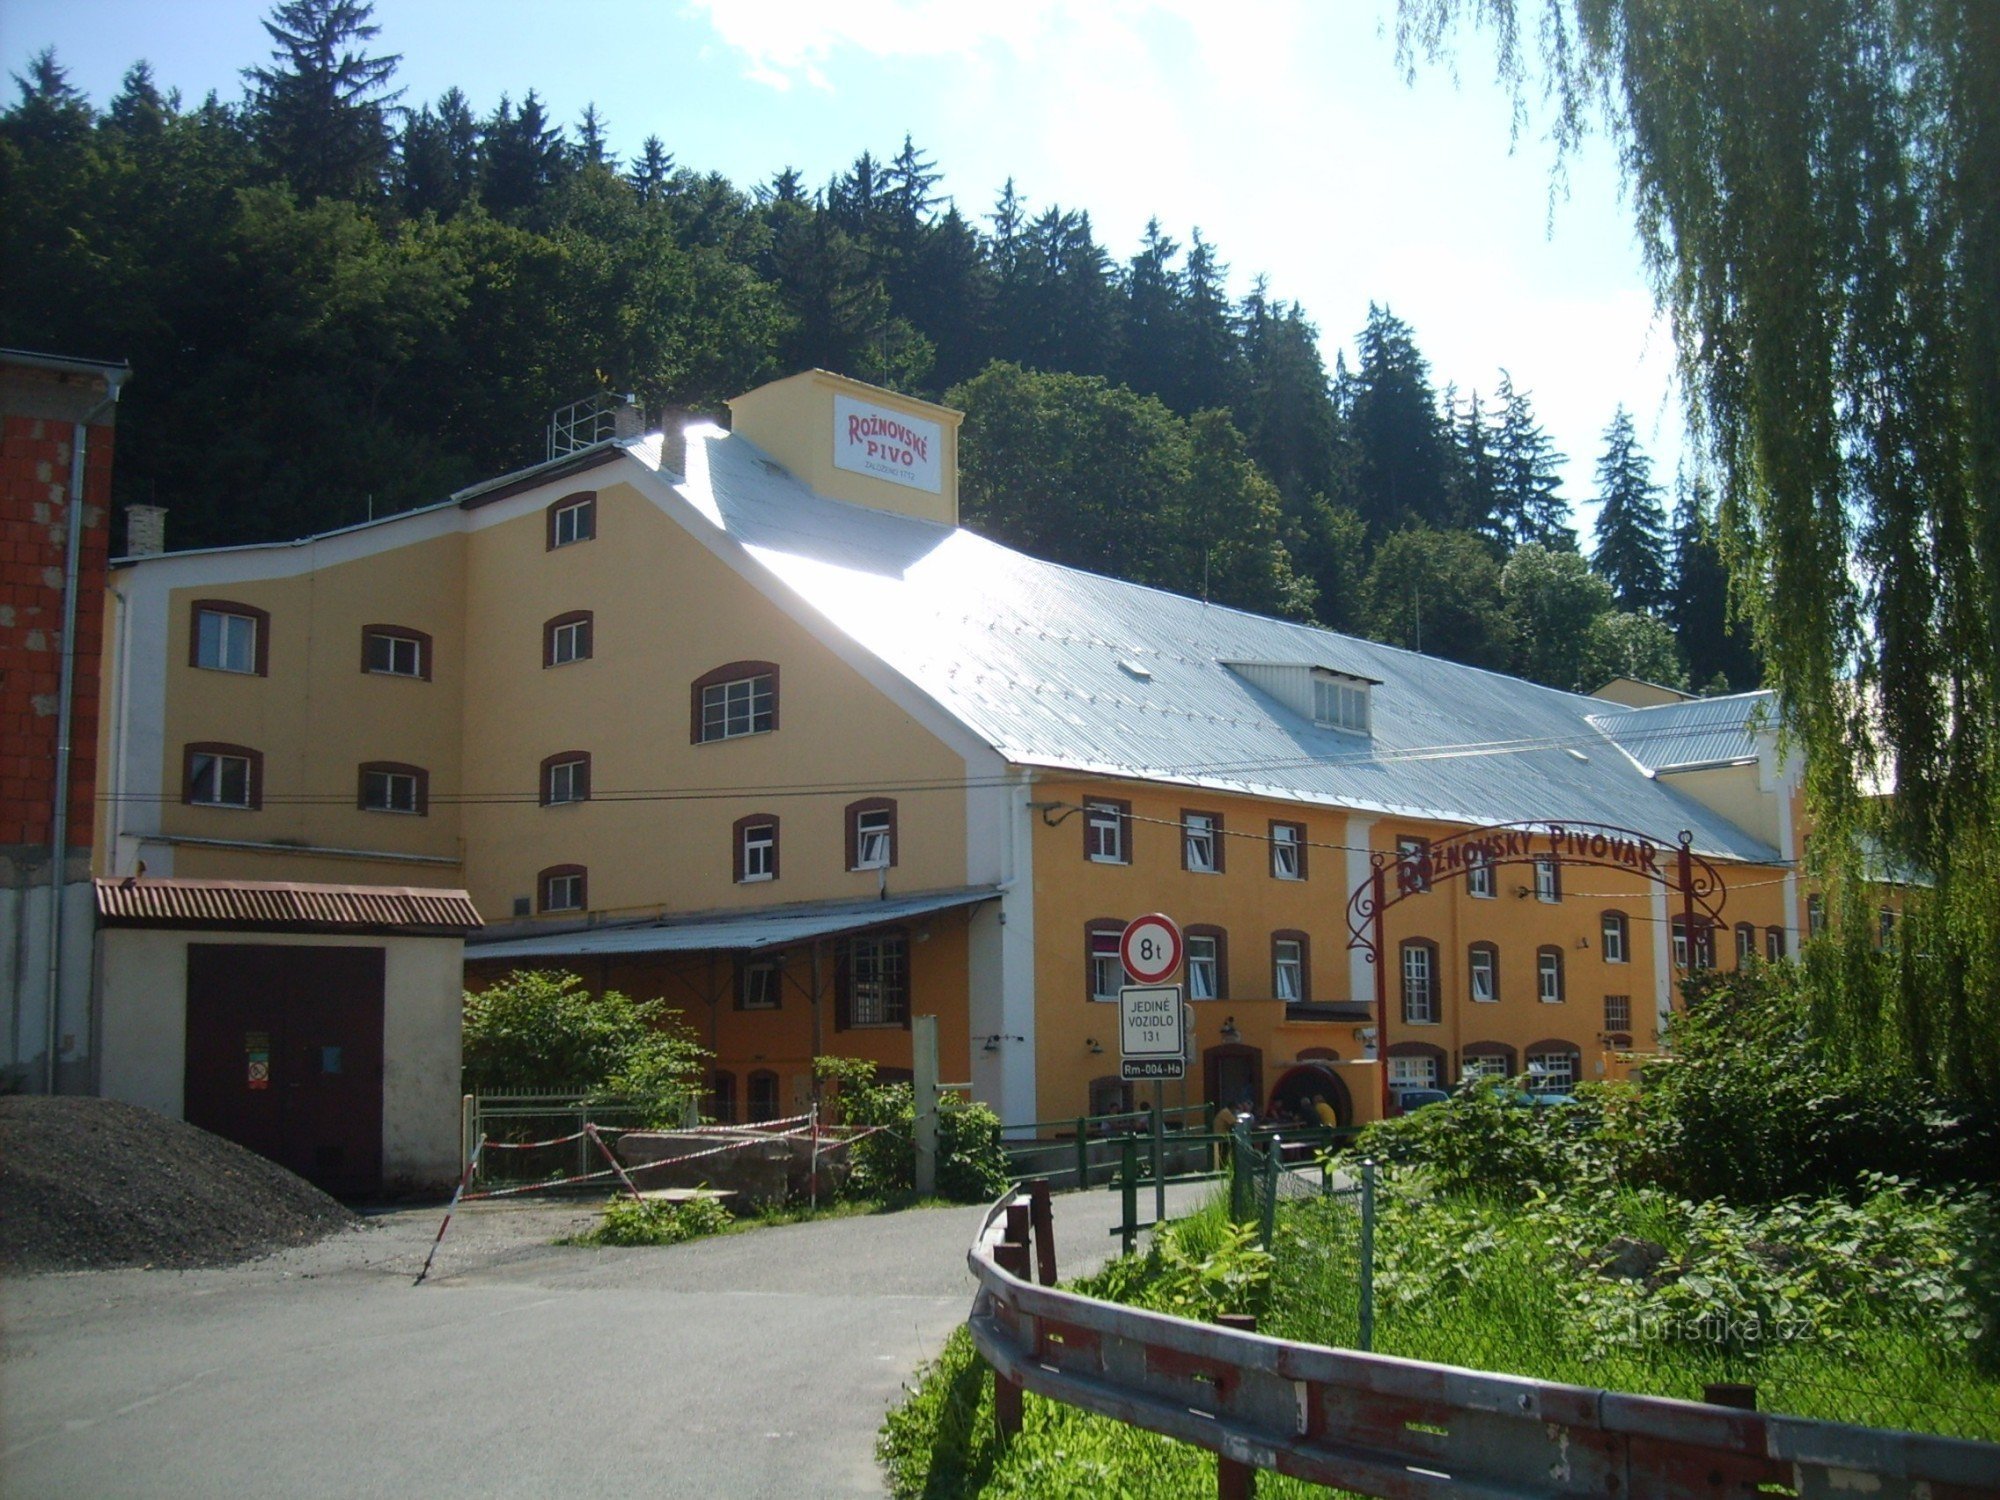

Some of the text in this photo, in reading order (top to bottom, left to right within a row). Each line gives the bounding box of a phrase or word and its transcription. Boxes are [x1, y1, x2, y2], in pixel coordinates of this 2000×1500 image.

[848, 414, 927, 463] ROŽNOVSKÉ
[867, 440, 914, 467] PIVO
[1550, 825, 1660, 875] PIVOVAR
[1140, 938, 1162, 961] 8 t
[1131, 997, 1170, 1013] JEDINÉ
[1128, 1015, 1174, 1028] VOZIDLO
[1143, 1031, 1154, 1042] 13
[1124, 1064, 1181, 1075] Rm-004-Ha
